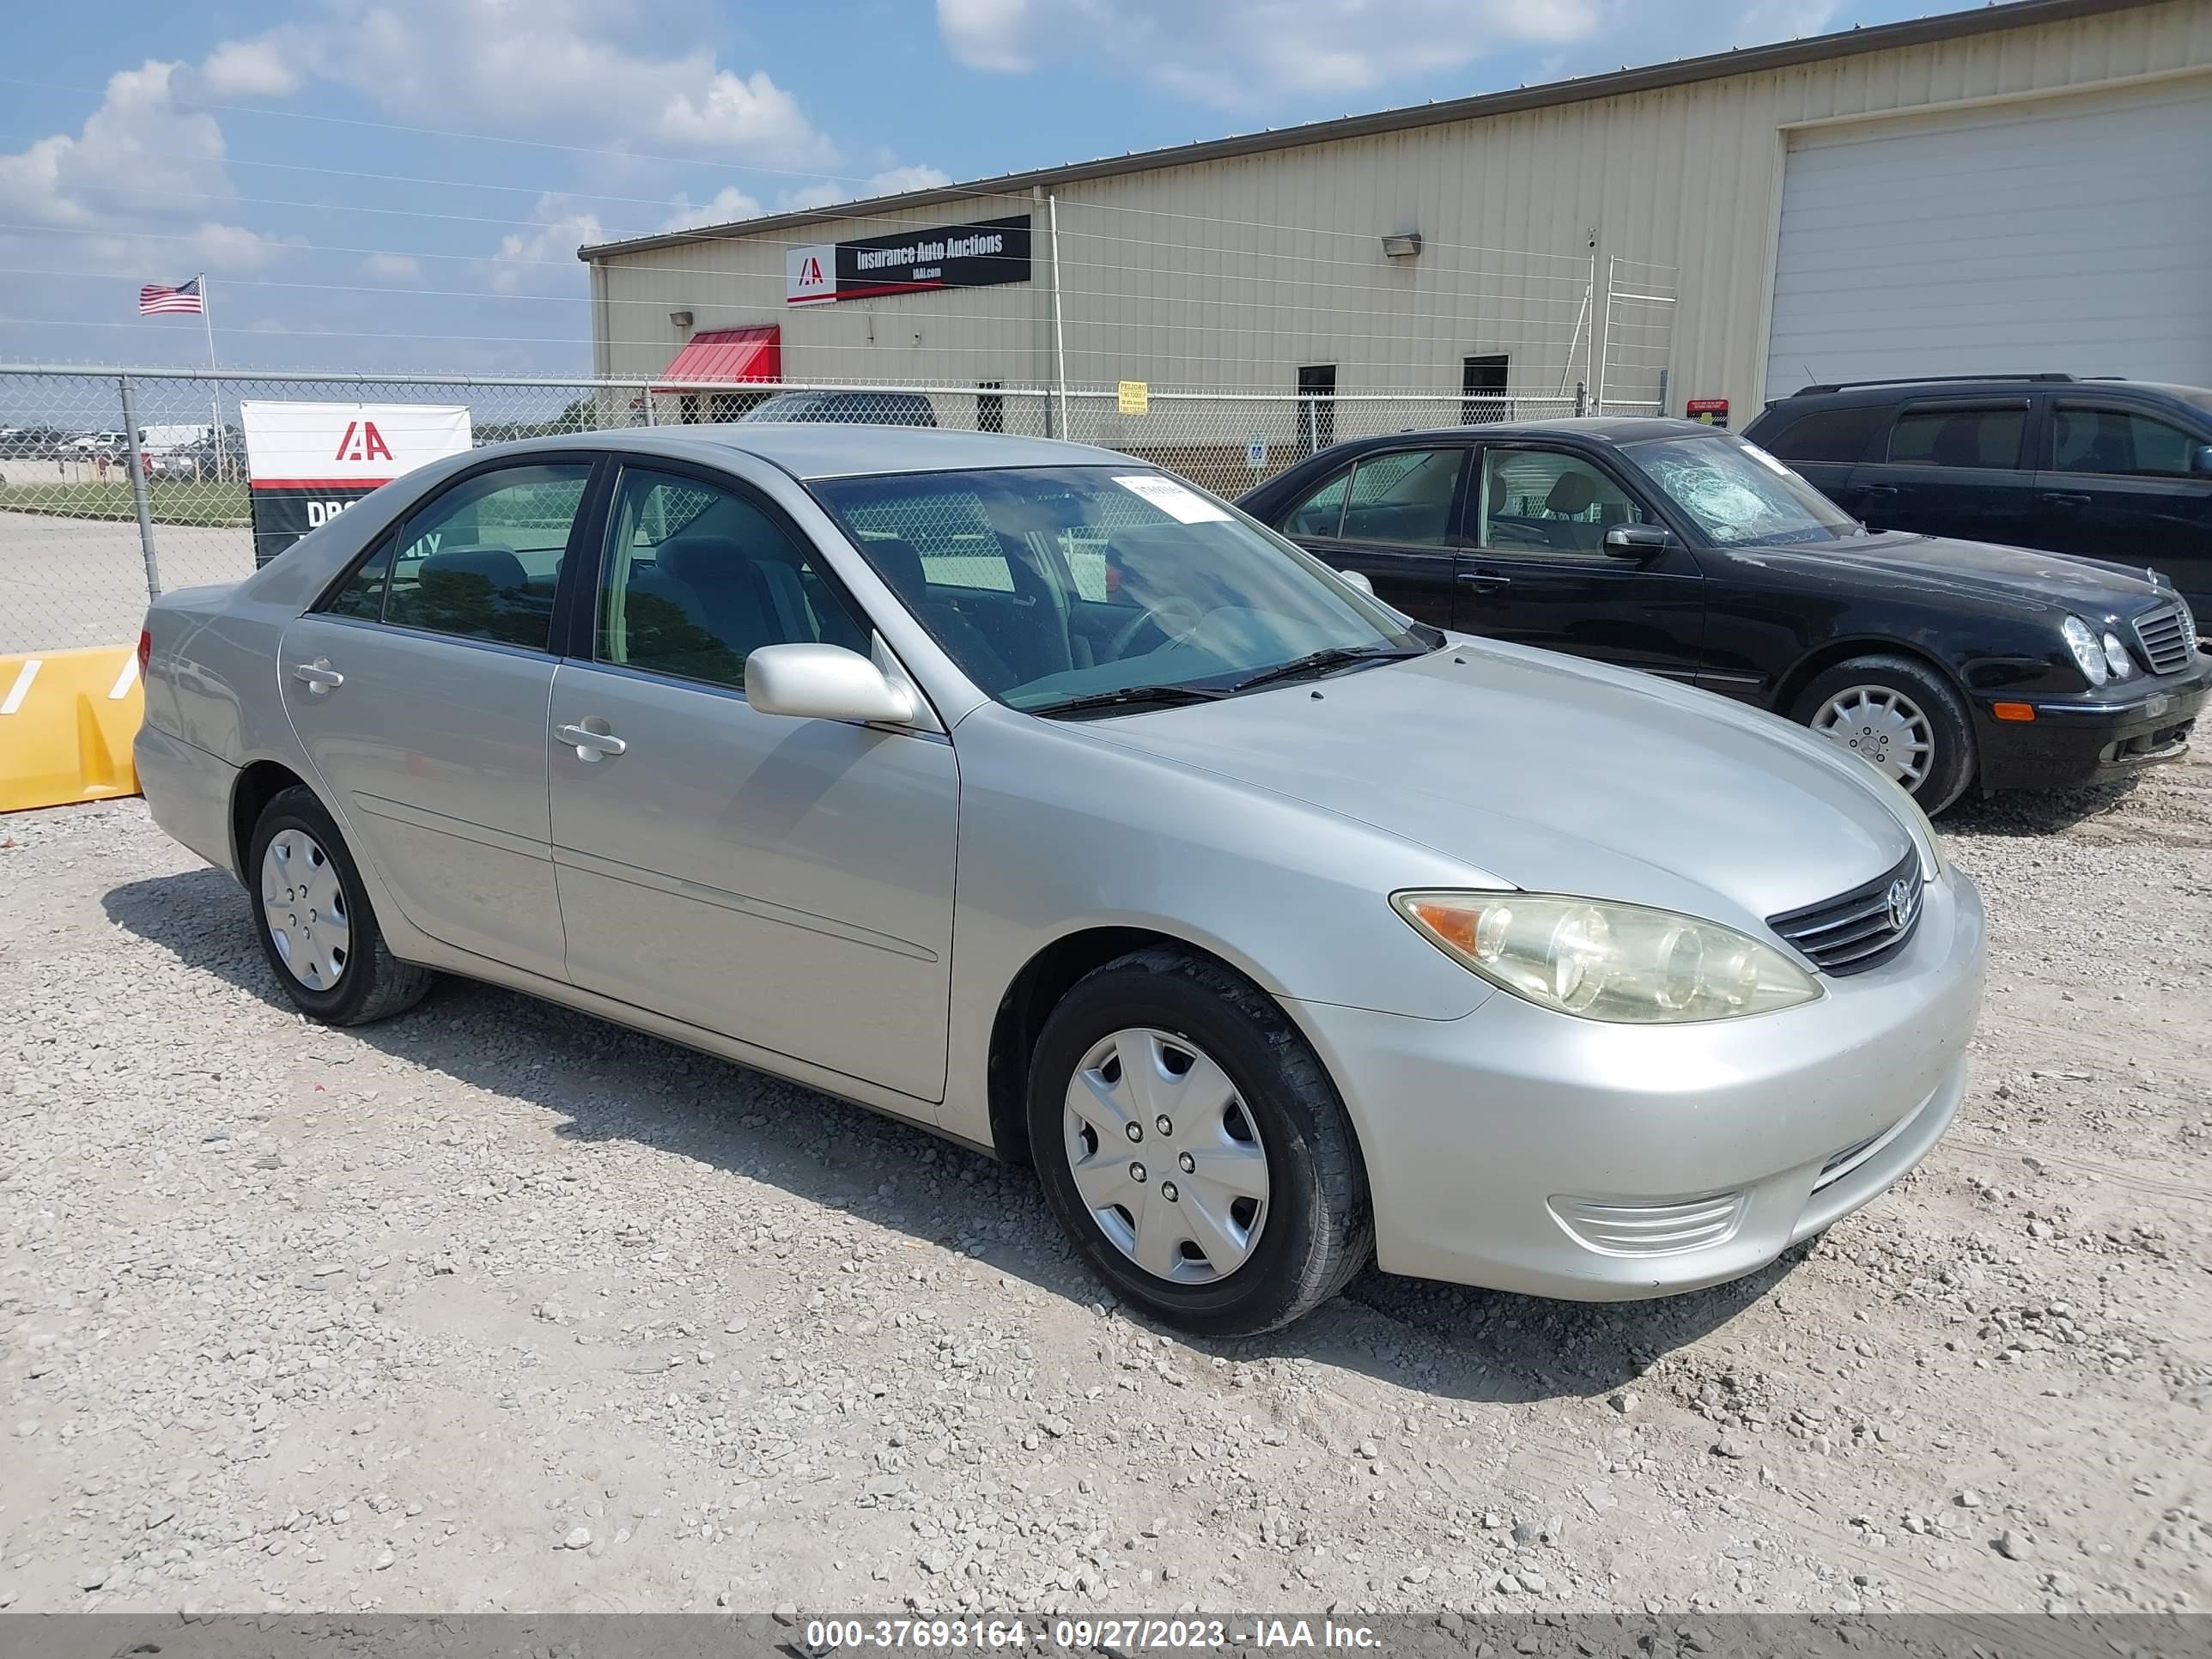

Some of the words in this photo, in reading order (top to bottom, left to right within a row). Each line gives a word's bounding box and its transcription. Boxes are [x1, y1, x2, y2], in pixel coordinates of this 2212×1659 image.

[857, 246, 915, 270] Insurance
[917, 242, 945, 263] Auto
[946, 234, 1003, 258] Auctions
